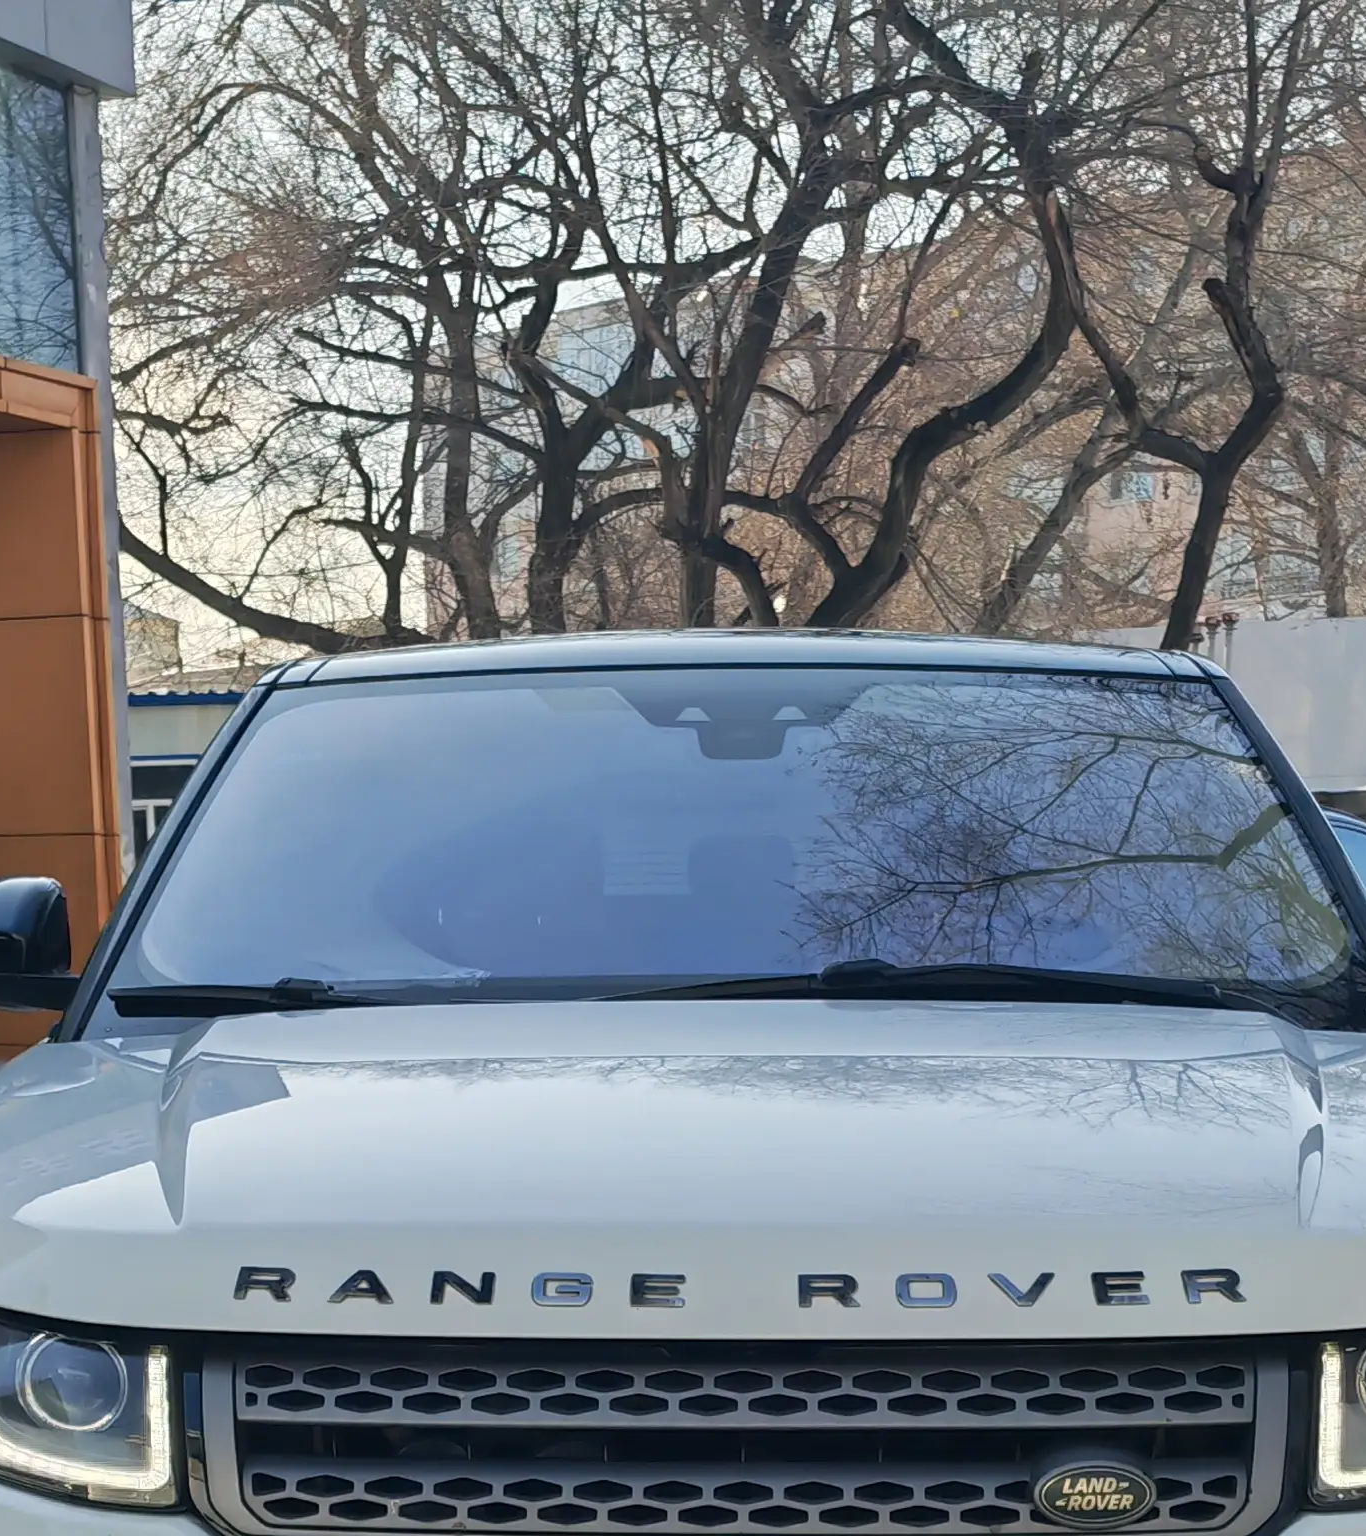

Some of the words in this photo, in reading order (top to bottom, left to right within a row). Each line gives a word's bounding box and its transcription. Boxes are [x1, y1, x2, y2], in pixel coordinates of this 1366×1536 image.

[233, 1266, 687, 1308] RANGE
[797, 1268, 1247, 1308] ROVER
[1062, 1477, 1119, 1494] LAND
[1065, 1494, 1134, 1511] ROVER
